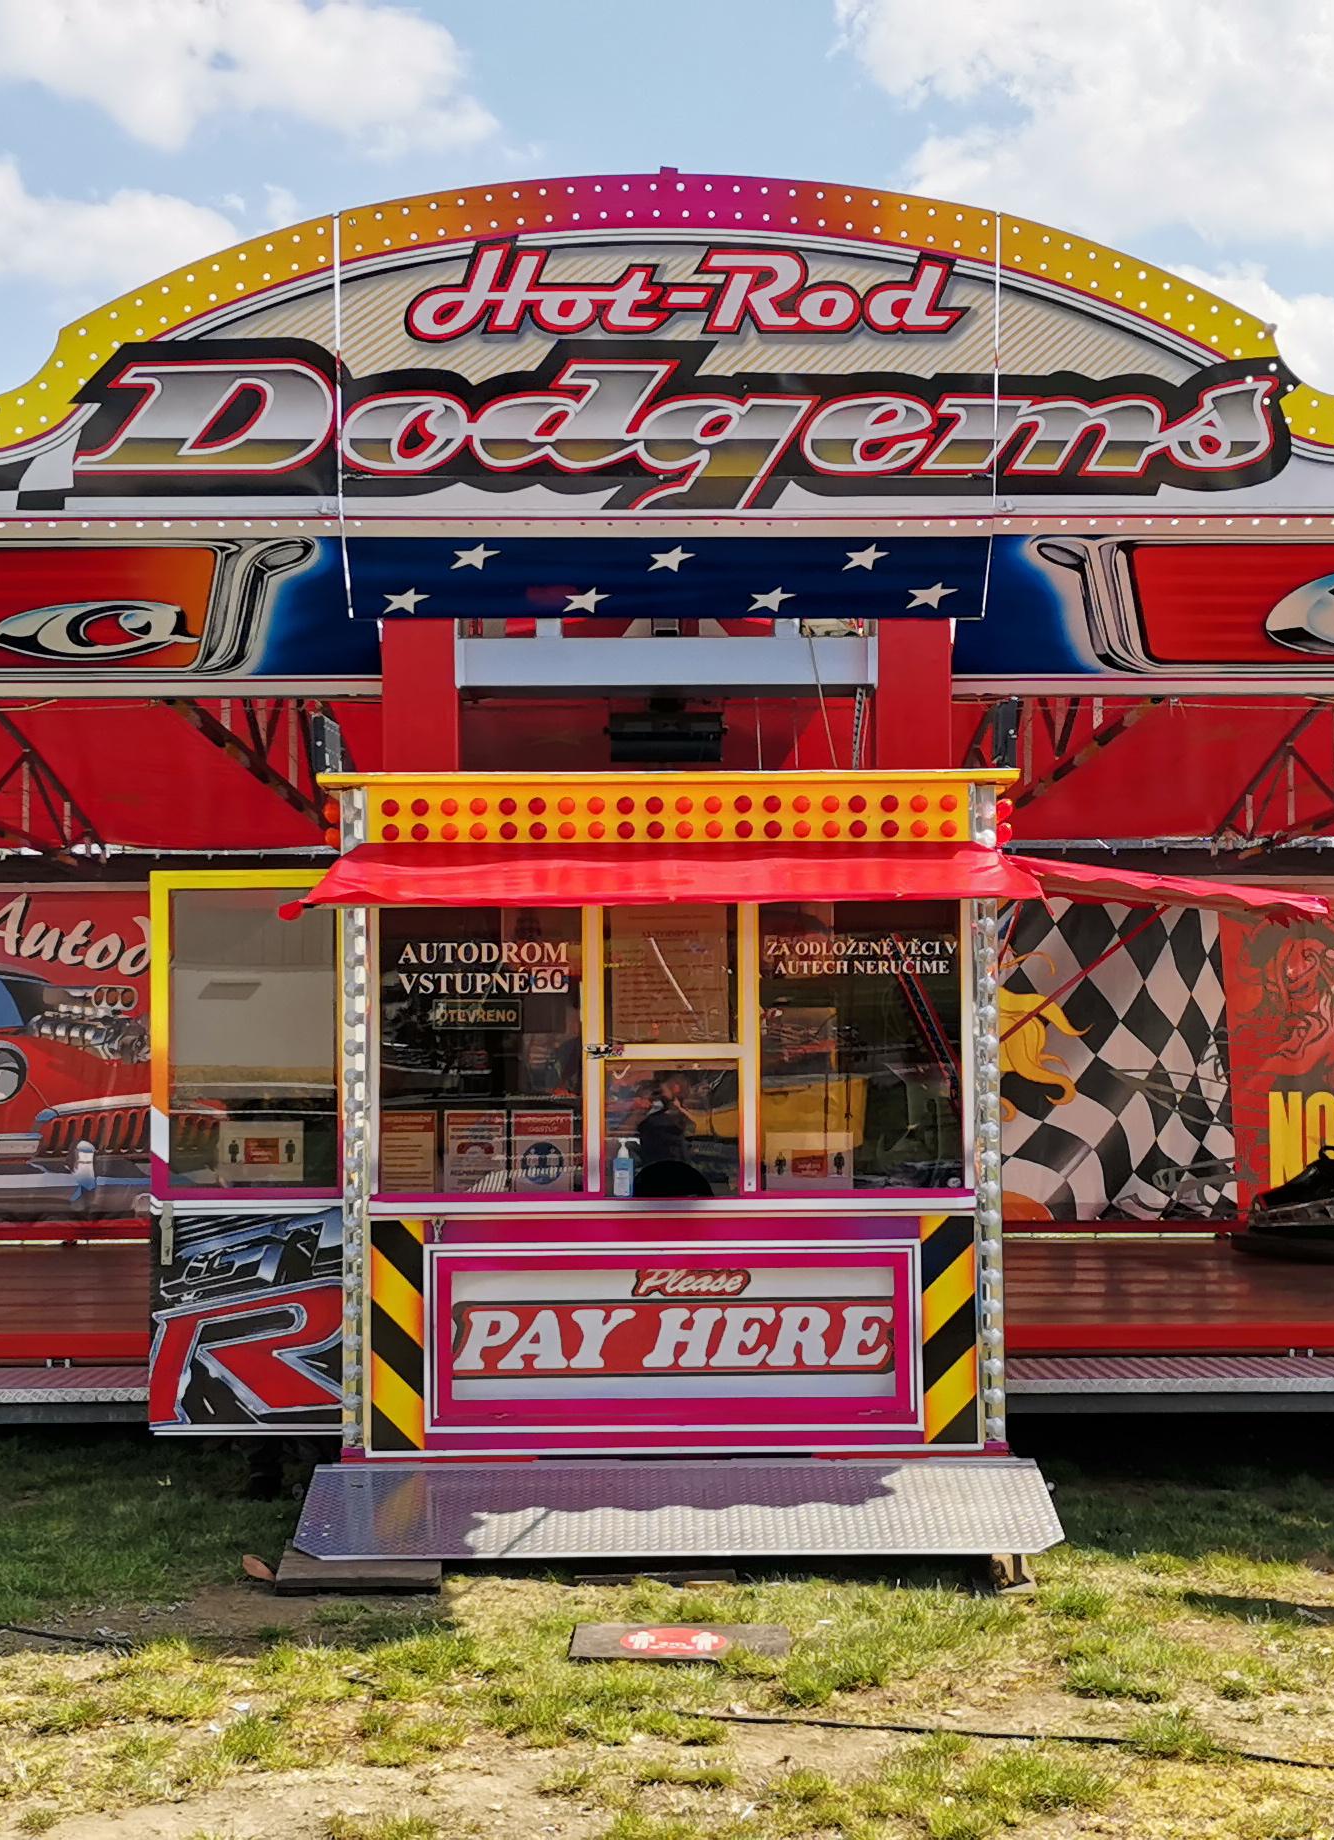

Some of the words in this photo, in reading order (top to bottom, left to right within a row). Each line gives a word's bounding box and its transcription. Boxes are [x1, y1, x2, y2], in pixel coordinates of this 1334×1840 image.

[406, 241, 970, 338] Hot-Rod
[74, 354, 1279, 510] Dodgems
[397, 941, 569, 964] AUTODROM
[767, 940, 791, 956] ZA
[795, 937, 894, 956] ODLOŽENÉ
[943, 940, 958, 955] V
[775, 959, 849, 975] AUTECH
[853, 956, 951, 975] NERUČÍME
[397, 966, 530, 994] VSTUPNÉ
[533, 968, 566, 991] 60
[639, 1269, 743, 1294] Please
[453, 1307, 637, 1370] PAY
[643, 1305, 894, 1368] HERE
